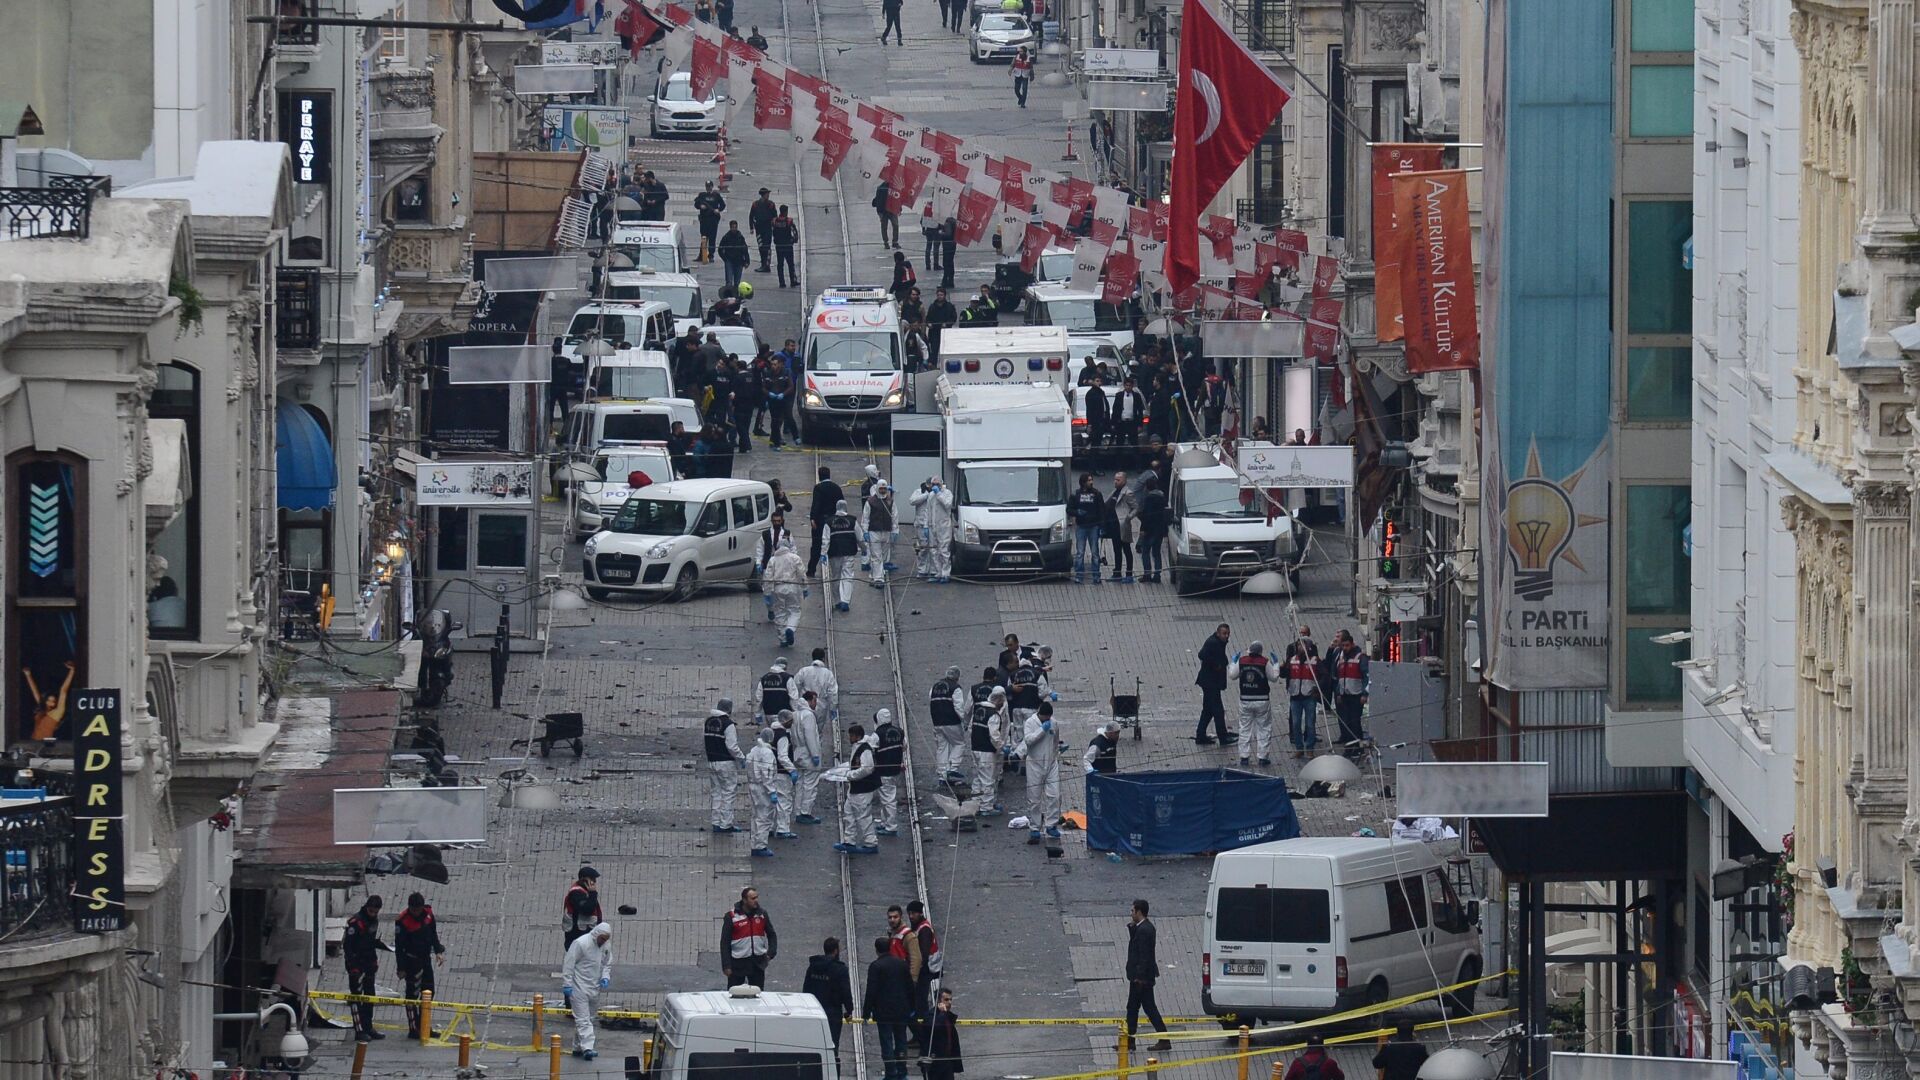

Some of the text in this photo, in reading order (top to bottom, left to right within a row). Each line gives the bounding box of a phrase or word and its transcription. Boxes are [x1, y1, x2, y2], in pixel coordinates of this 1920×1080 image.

[545, 114, 561, 122] WC
[897, 129, 914, 138] CHP
[299, 99, 315, 181] FERAYE
[962, 152, 979, 160] CHP
[1028, 177, 1045, 185] CHP
[1140, 243, 1158, 251] CHP
[1078, 263, 1096, 272] CHP
[1106, 282, 1122, 292] CHP
[1206, 279, 1223, 287] CHP
[1432, 281, 1456, 353] KÜLTÜR
[78, 696, 115, 711] CLUB
[81, 714, 112, 911] ADRESS
